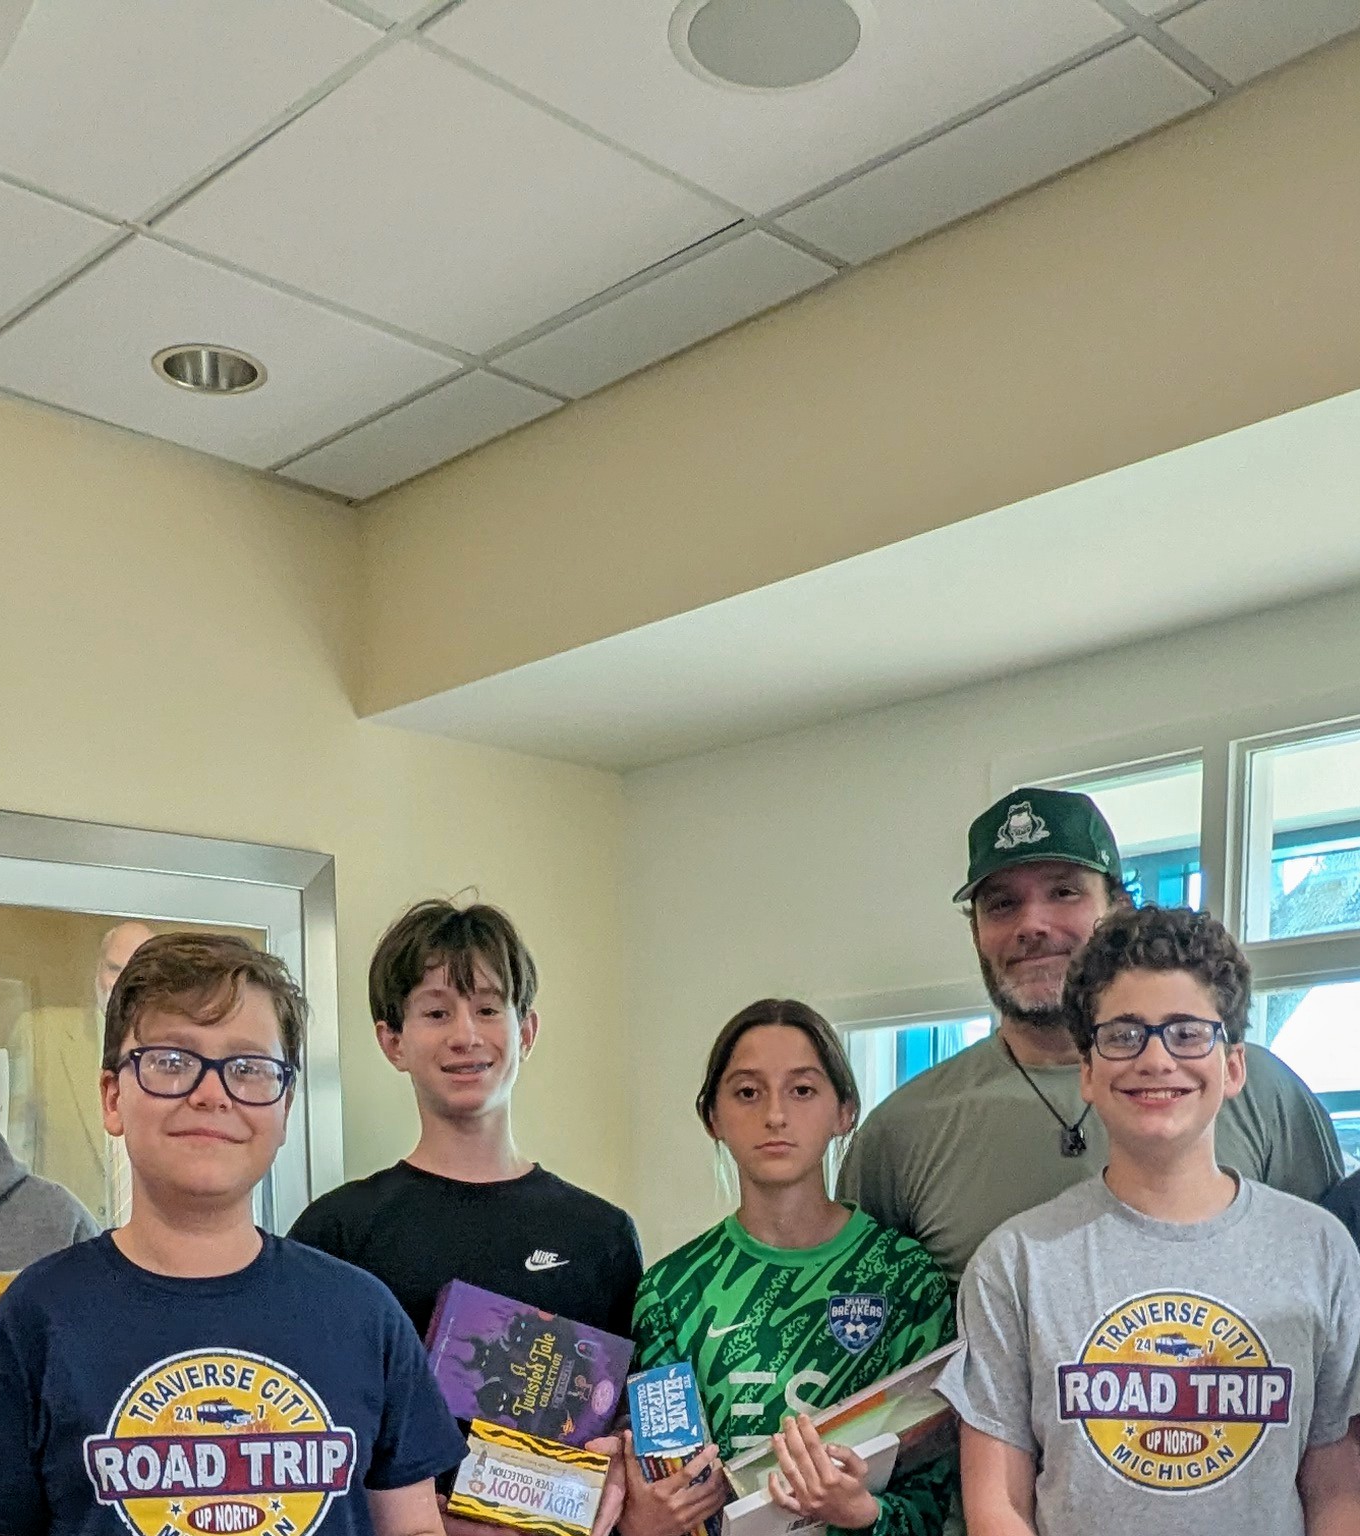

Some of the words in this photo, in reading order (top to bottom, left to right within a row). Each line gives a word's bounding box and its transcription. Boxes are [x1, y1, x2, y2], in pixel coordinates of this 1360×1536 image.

[531, 1249, 559, 1264] NIKE
[831, 1304, 883, 1318] BREAKERS
[844, 1297, 871, 1306] MIAMI
[1096, 1302, 1208, 1352] TRAVERSE
[1212, 1317, 1258, 1361] CITY
[1135, 1338, 1151, 1351] 24
[529, 1333, 556, 1362] Tale
[130, 1364, 256, 1423] TRAVERSE
[260, 1378, 316, 1426] CITY
[512, 1361, 547, 1416] Twisted
[539, 1353, 563, 1408] COLLECTION
[1065, 1371, 1177, 1414] ROAD
[1190, 1373, 1286, 1416] TRIP
[175, 1406, 193, 1421] 24
[257, 1405, 265, 1419] 7
[636, 1383, 651, 1438] COLLECTION
[646, 1380, 669, 1437] ZIPZER
[664, 1376, 689, 1433] HANK
[1145, 1431, 1162, 1449] UP
[1163, 1429, 1202, 1456] NORTH
[94, 1443, 226, 1492] ROAD
[240, 1440, 348, 1487] TRIP
[489, 1465, 534, 1486] COLLECTION
[1112, 1444, 1235, 1481] MICHIGAN
[487, 1478, 546, 1509] MOODY
[544, 1493, 584, 1519] JUDY
[194, 1510, 213, 1531] UP
[214, 1505, 258, 1532] NORTH
